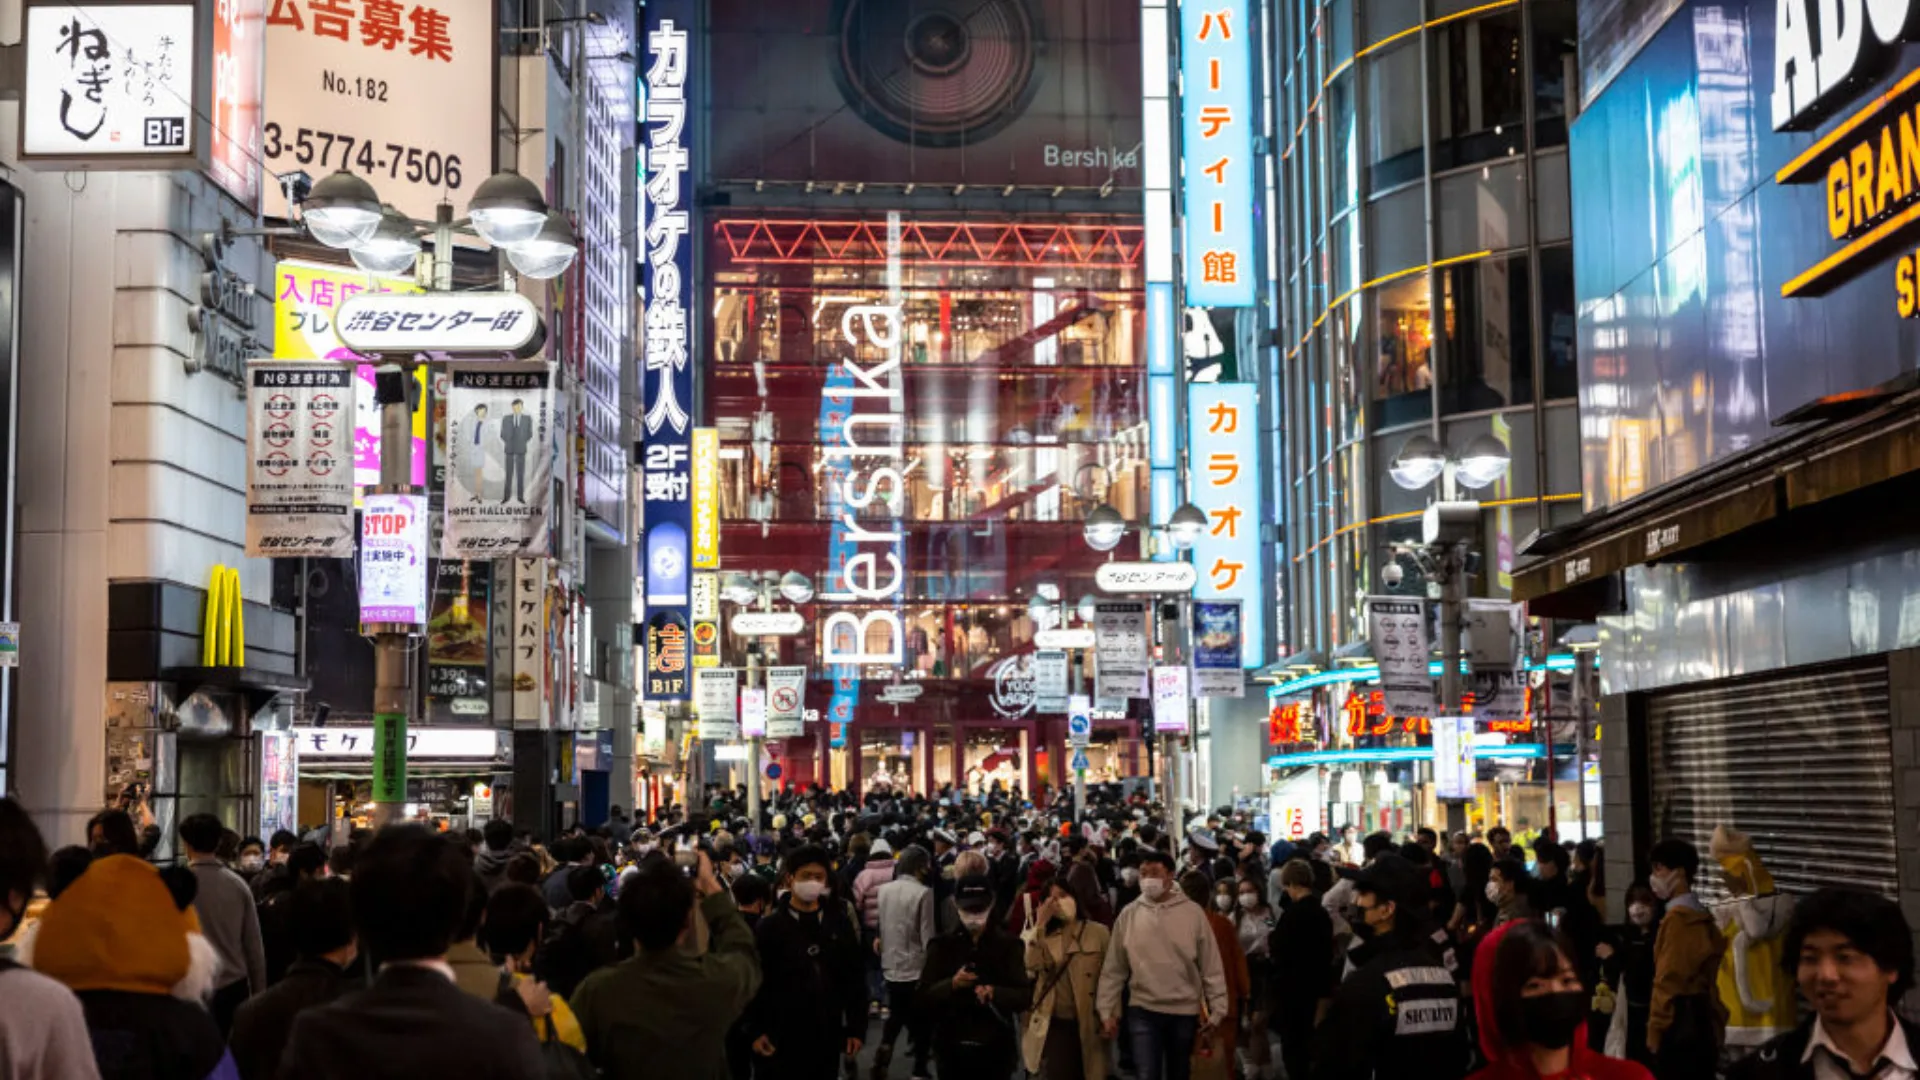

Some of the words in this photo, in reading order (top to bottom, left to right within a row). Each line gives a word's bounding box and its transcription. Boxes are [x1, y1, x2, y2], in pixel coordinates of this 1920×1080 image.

[56, 16, 111, 141] ねぎし
[322, 69, 389, 103] No.182
[1771, 0, 1909, 131] AB
[147, 119, 184, 144] B1F
[263, 122, 463, 189] 3-5774-7506
[1044, 144, 1138, 168] Bershka
[1198, 10, 1236, 283] パーティー館
[645, 19, 689, 435] カラオケの鉄人
[344, 308, 524, 334] 渋谷センター街
[645, 472, 690, 501] 受付
[821, 298, 905, 664] Bershka
[1208, 402, 1243, 590] カラオケ
[652, 679, 683, 694] B1F
